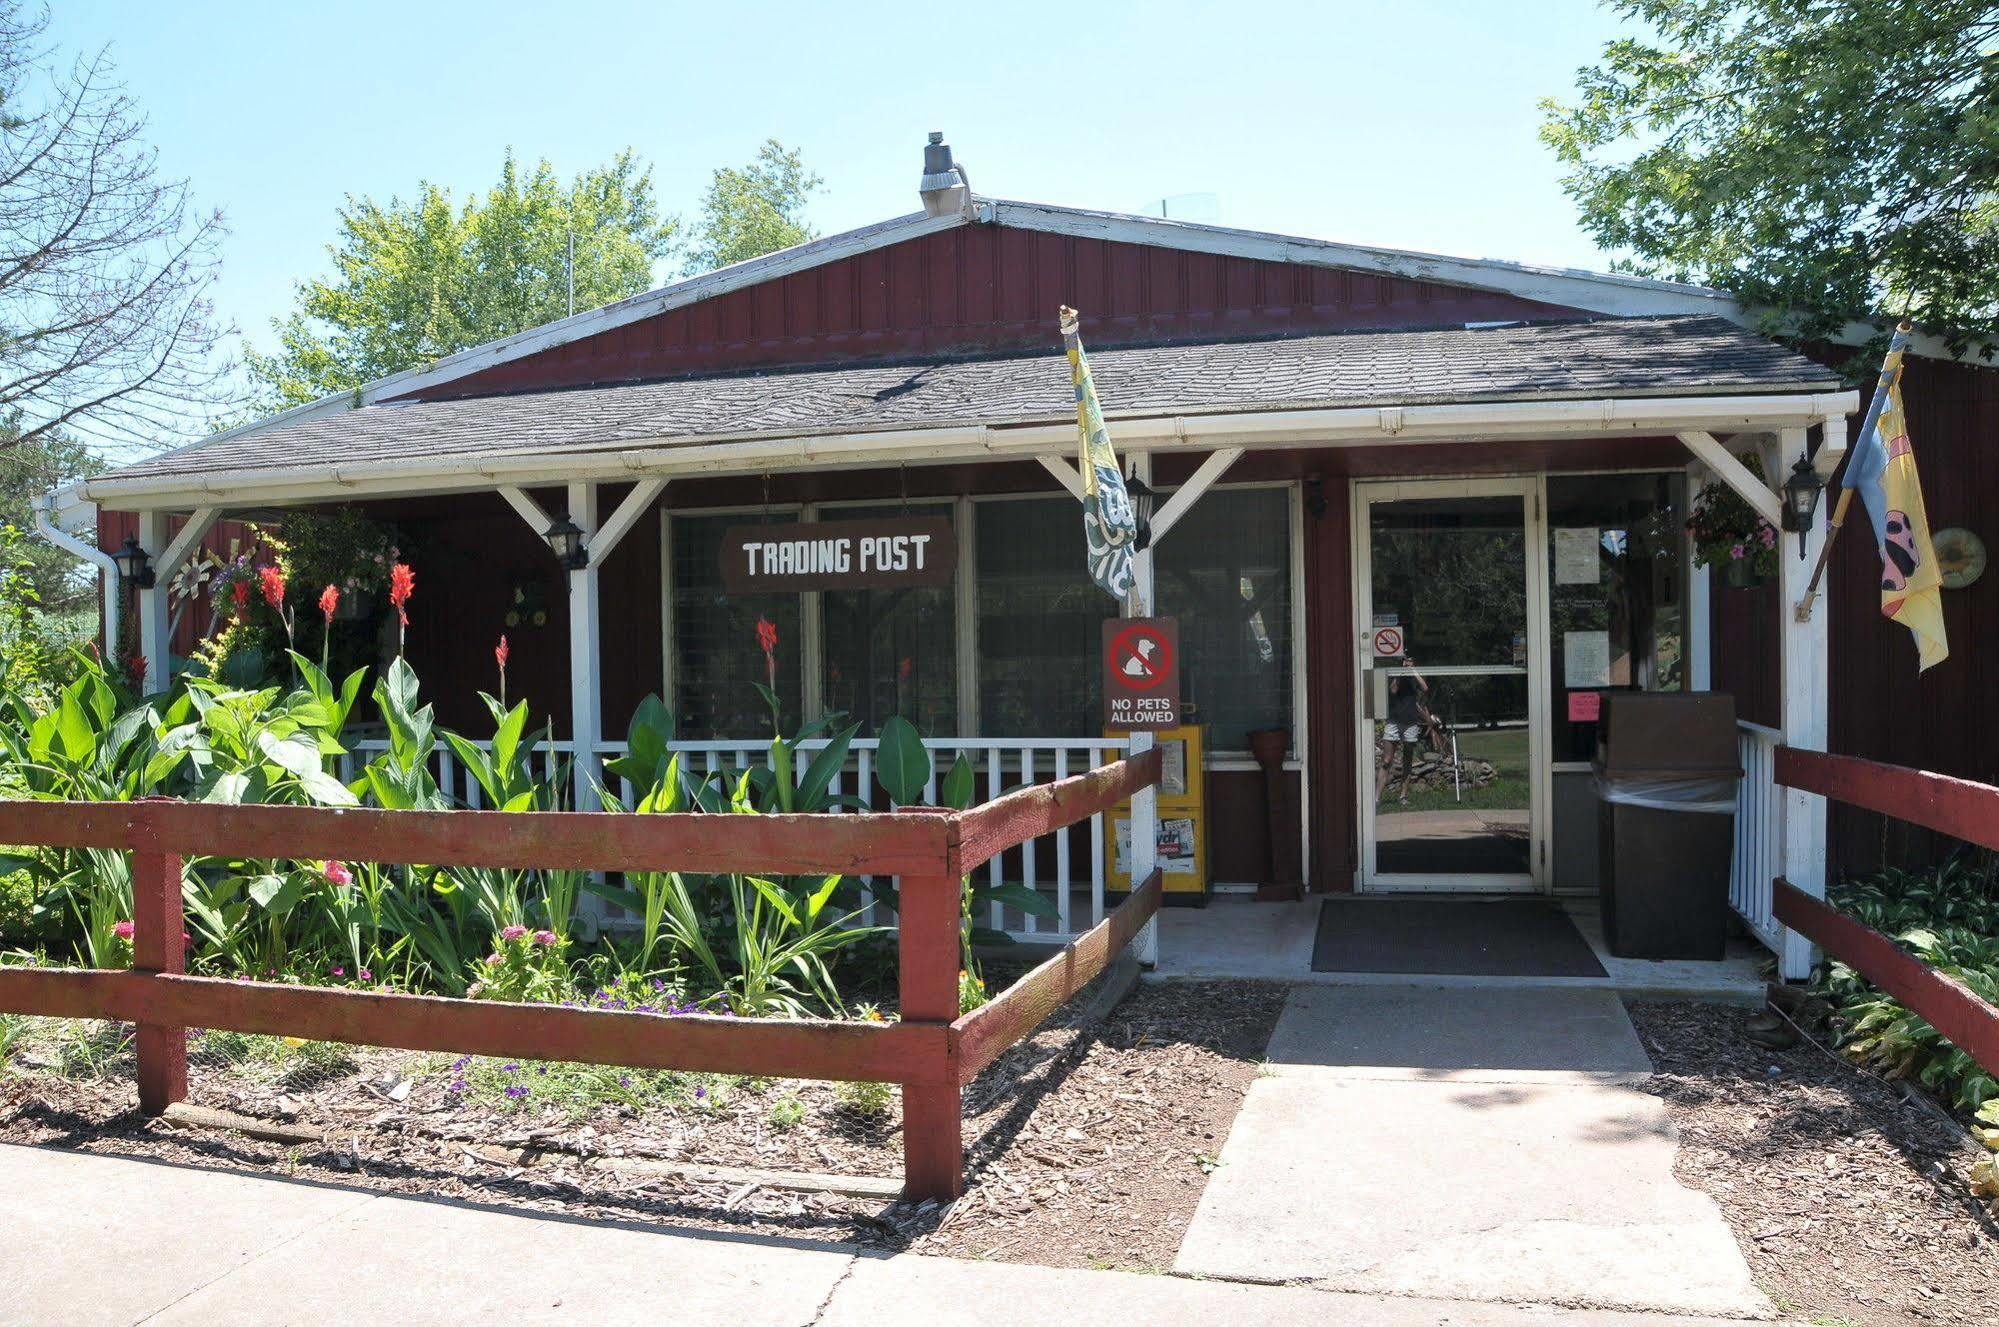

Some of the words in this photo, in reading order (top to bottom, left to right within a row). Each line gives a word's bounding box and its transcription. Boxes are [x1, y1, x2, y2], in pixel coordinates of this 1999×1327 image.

[742, 539, 850, 575] TRADING
[860, 535, 930, 572] POST
[1111, 698, 1131, 710] NO
[1137, 698, 1171, 710] PETS
[1111, 711, 1174, 723] ALLOWED
